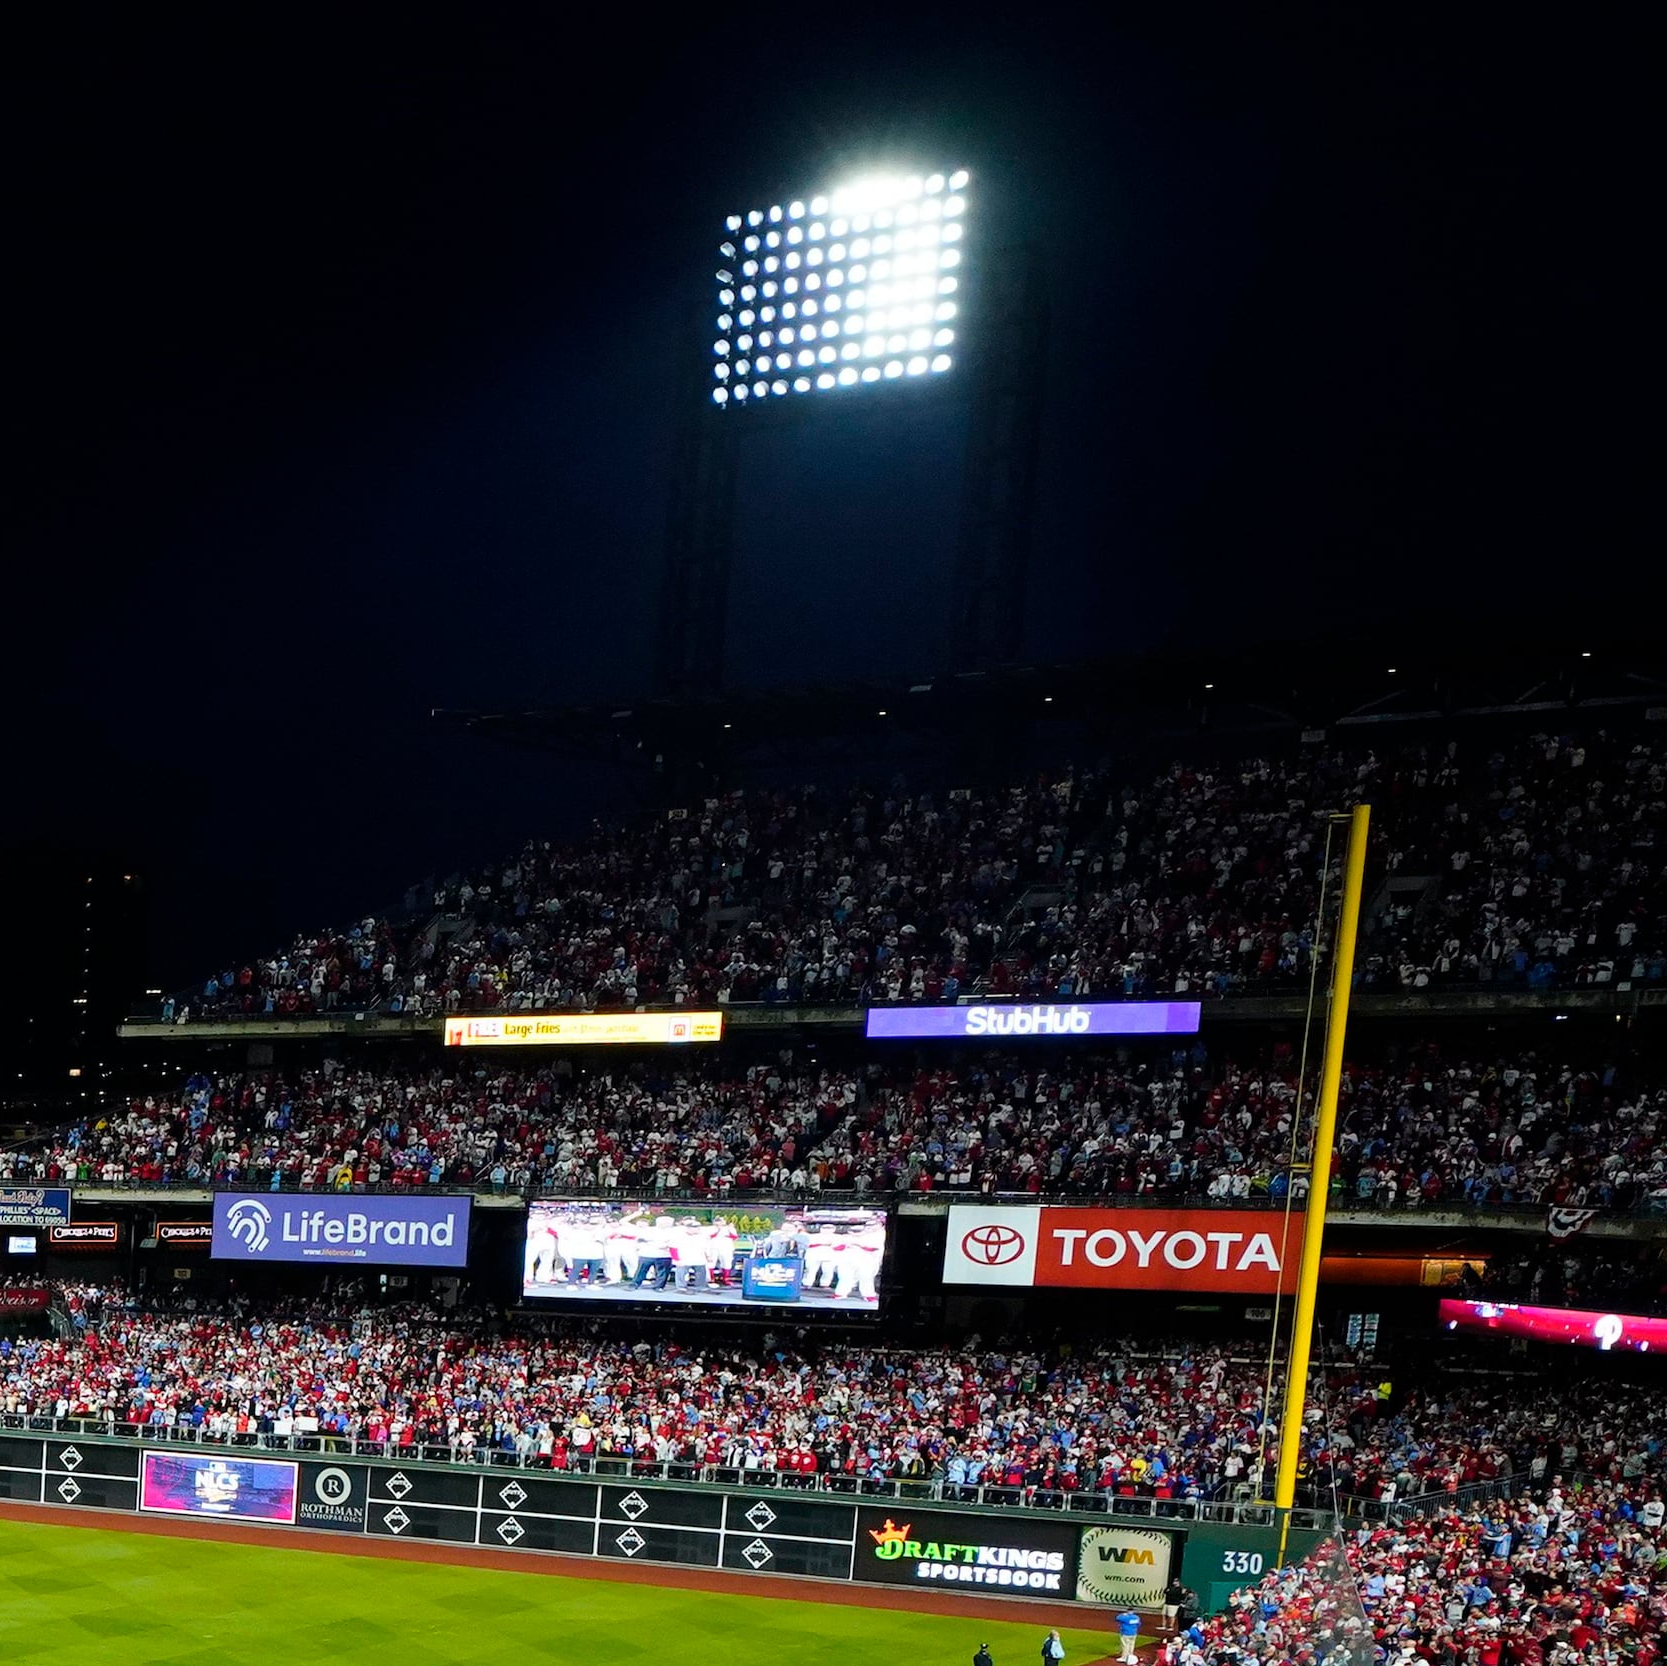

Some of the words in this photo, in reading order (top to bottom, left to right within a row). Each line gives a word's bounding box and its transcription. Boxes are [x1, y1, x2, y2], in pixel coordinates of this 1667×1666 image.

[505, 1022, 534, 1035] Large
[536, 1022, 561, 1034] Fries
[966, 1005, 1087, 1034] StubHub
[0, 1215, 33, 1223] LOCATION
[35, 1216, 44, 1224] TO
[283, 1210, 455, 1247] LifeBrand
[1053, 1229, 1281, 1273] TOYOTA
[195, 1471, 241, 1491] NLCS
[327, 1480, 341, 1494] R
[300, 1503, 363, 1517] ROTHMAN
[300, 1512, 363, 1523] ORTHOPAEDICS
[875, 1537, 1065, 1572] DRAFTKINGS
[1098, 1545, 1155, 1566] WM
[1222, 1550, 1264, 1576] 330
[917, 1562, 1060, 1590] SPORTSBOOK
[1104, 1573, 1145, 1585] wm.com
